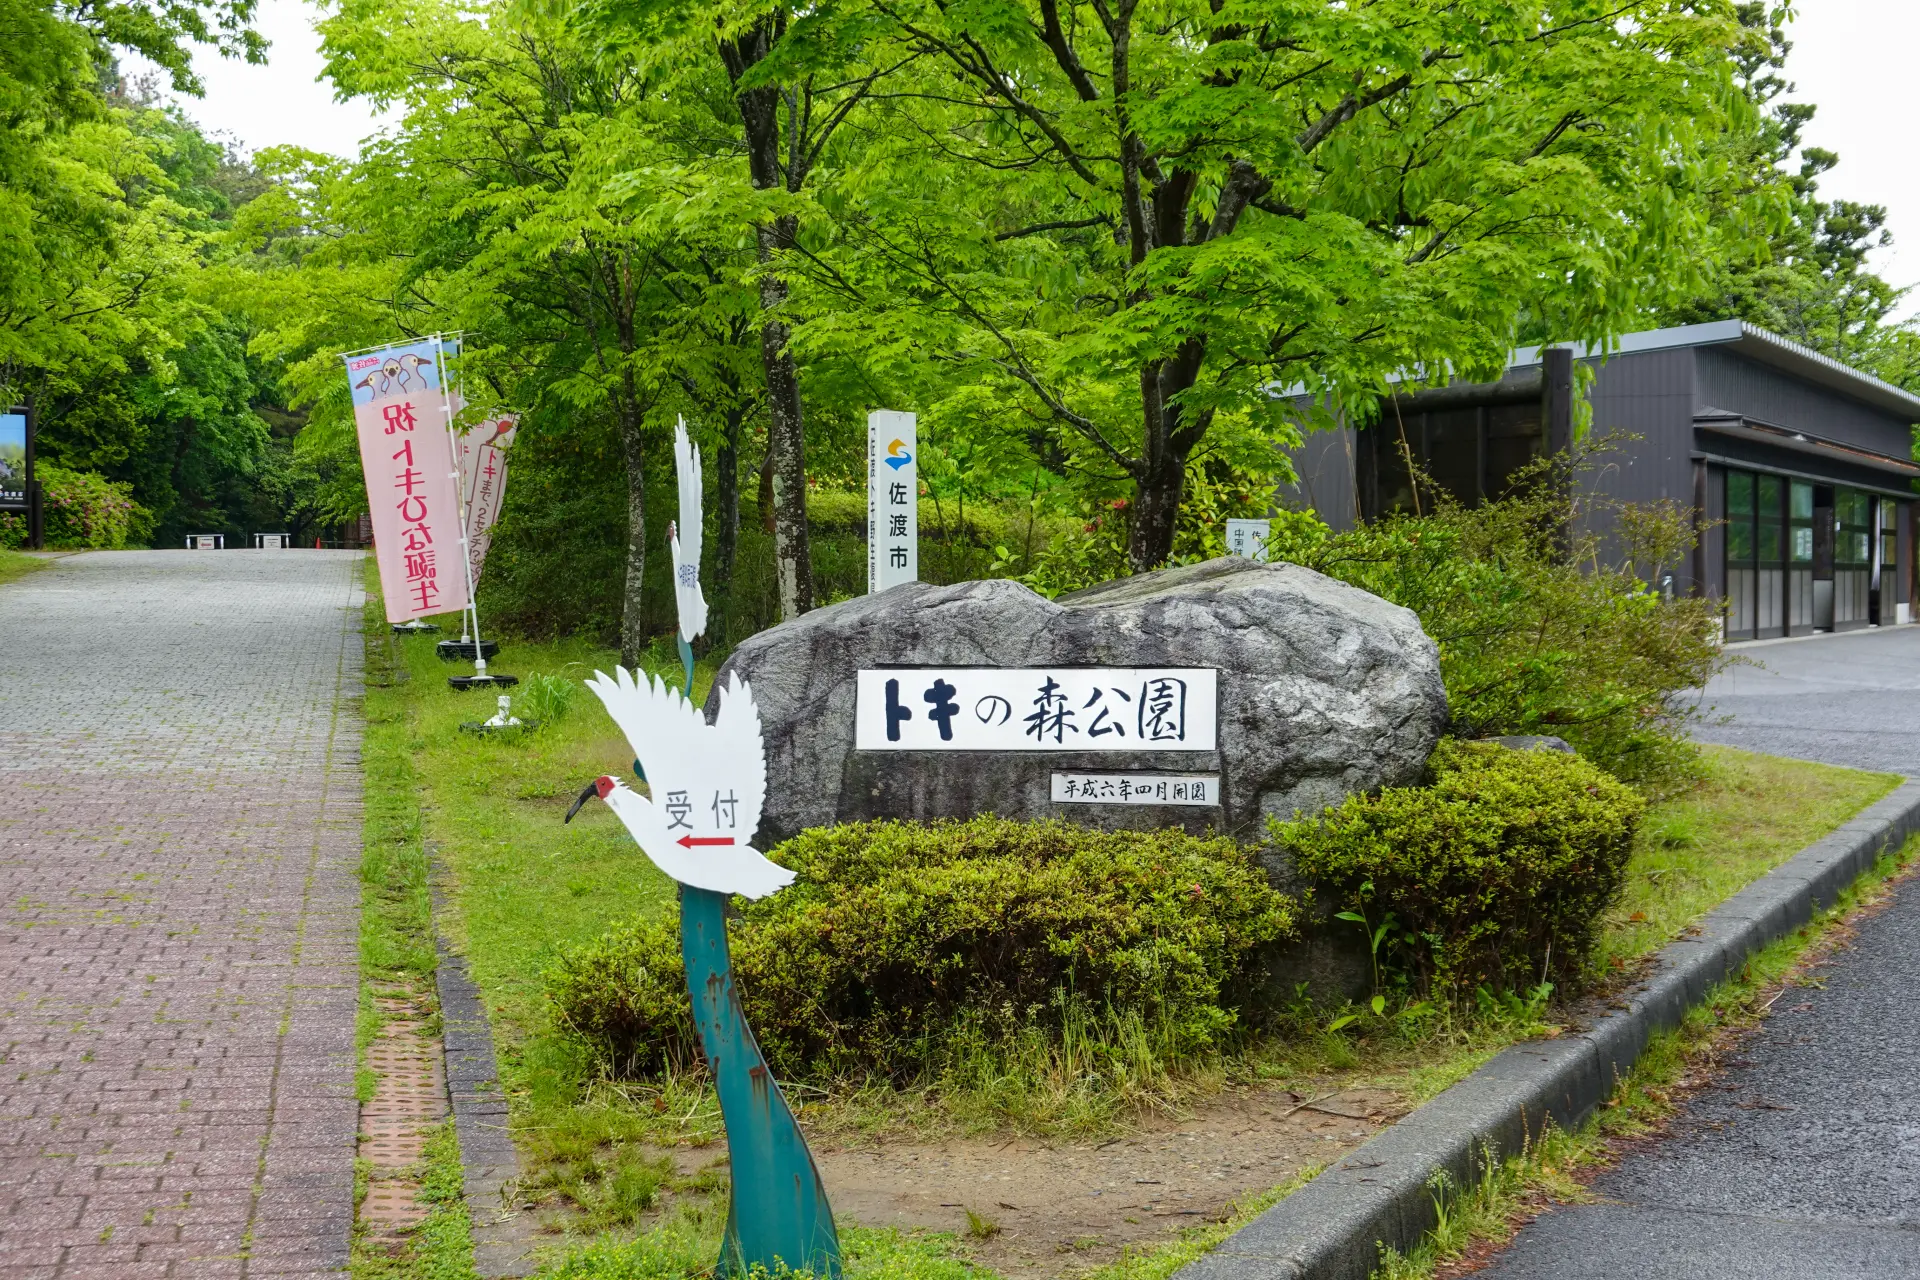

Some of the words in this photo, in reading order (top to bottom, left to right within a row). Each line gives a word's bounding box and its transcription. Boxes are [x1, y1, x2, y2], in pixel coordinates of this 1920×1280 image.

[889, 482, 908, 569] 佐渡市
[885, 676, 1187, 743] トキの森公園
[665, 789, 739, 830] 受付
[1064, 779, 1206, 801] 平成六年四月開園
